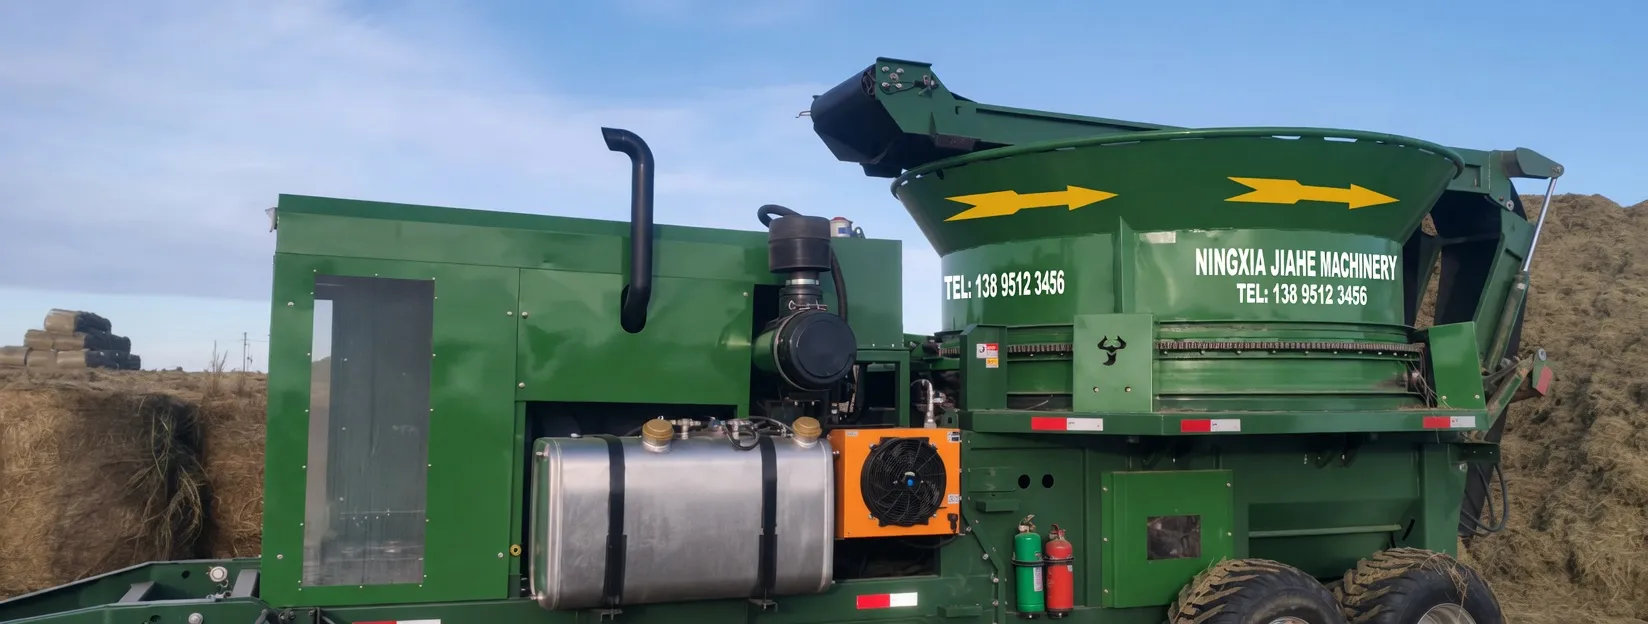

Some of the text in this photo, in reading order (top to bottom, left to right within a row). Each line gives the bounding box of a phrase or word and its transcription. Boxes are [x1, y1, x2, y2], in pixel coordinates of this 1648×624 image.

[1195, 247, 1398, 281] NINGXIA JIAHE MACHINERY
[943, 269, 1065, 301] TEL: 138 9512 3456
[1236, 282, 1368, 306] TEL: 138 9512 3456
